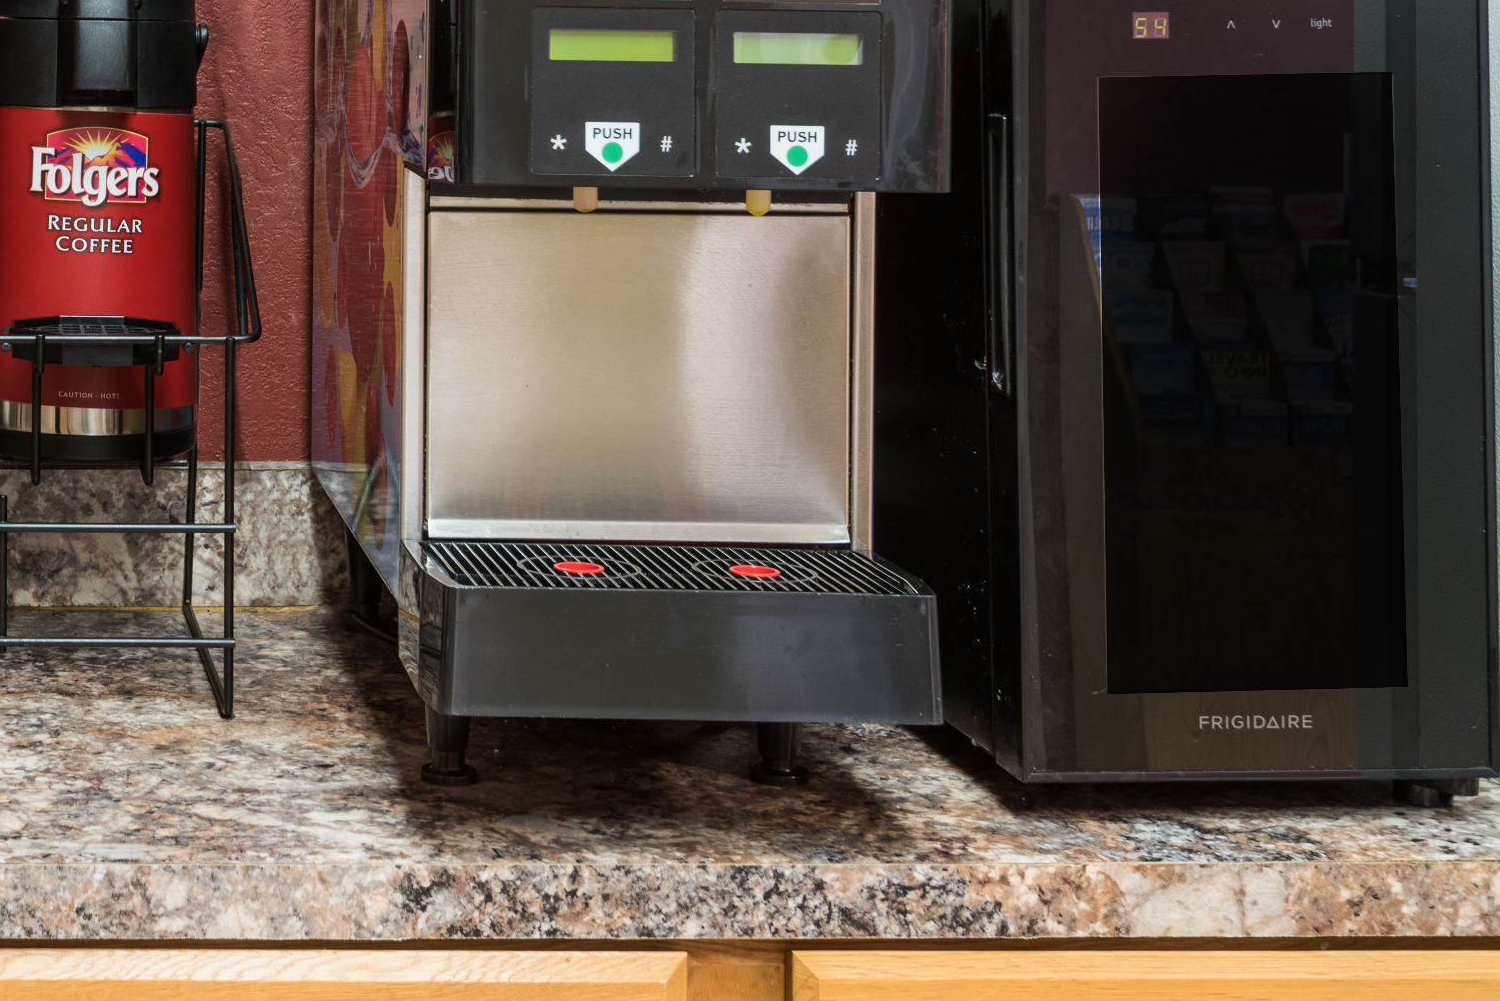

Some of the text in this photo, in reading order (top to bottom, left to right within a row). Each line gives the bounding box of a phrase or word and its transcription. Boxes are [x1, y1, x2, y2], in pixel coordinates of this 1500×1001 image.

[1310, 17, 1333, 30] light
[593, 127, 633, 140] PUSH
[777, 130, 818, 143] PUSH
[29, 144, 160, 207] Folgers
[47, 215, 143, 234] REGULAR
[55, 235, 133, 254] COFFEE
[58, 391, 93, 399] CAUTION
[1199, 714, 1313, 730] FRIGIDAIRE
